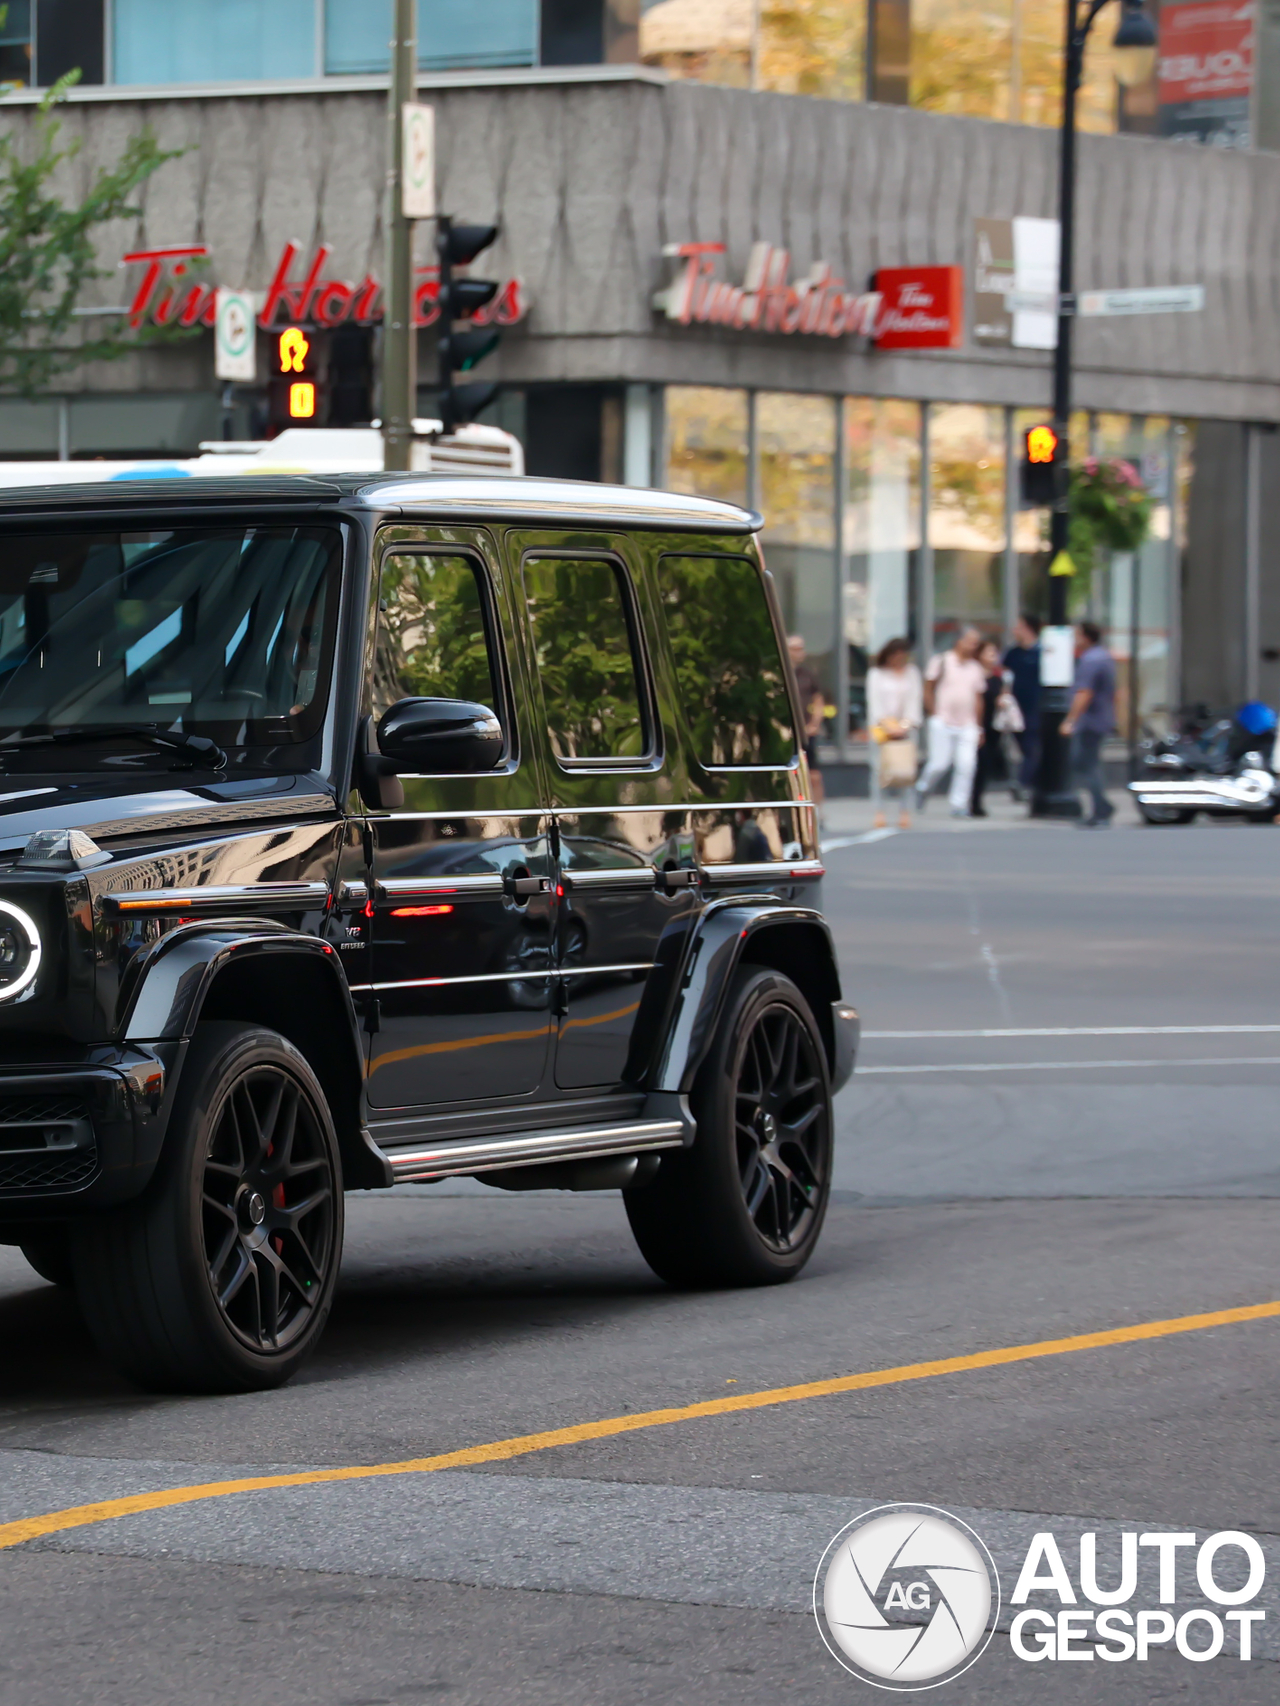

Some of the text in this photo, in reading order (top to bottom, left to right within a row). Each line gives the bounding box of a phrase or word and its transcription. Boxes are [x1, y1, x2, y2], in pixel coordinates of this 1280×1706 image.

[122, 239, 523, 329] Tim Horos
[898, 282, 934, 307] Tim
[345, 927, 361, 937] V8
